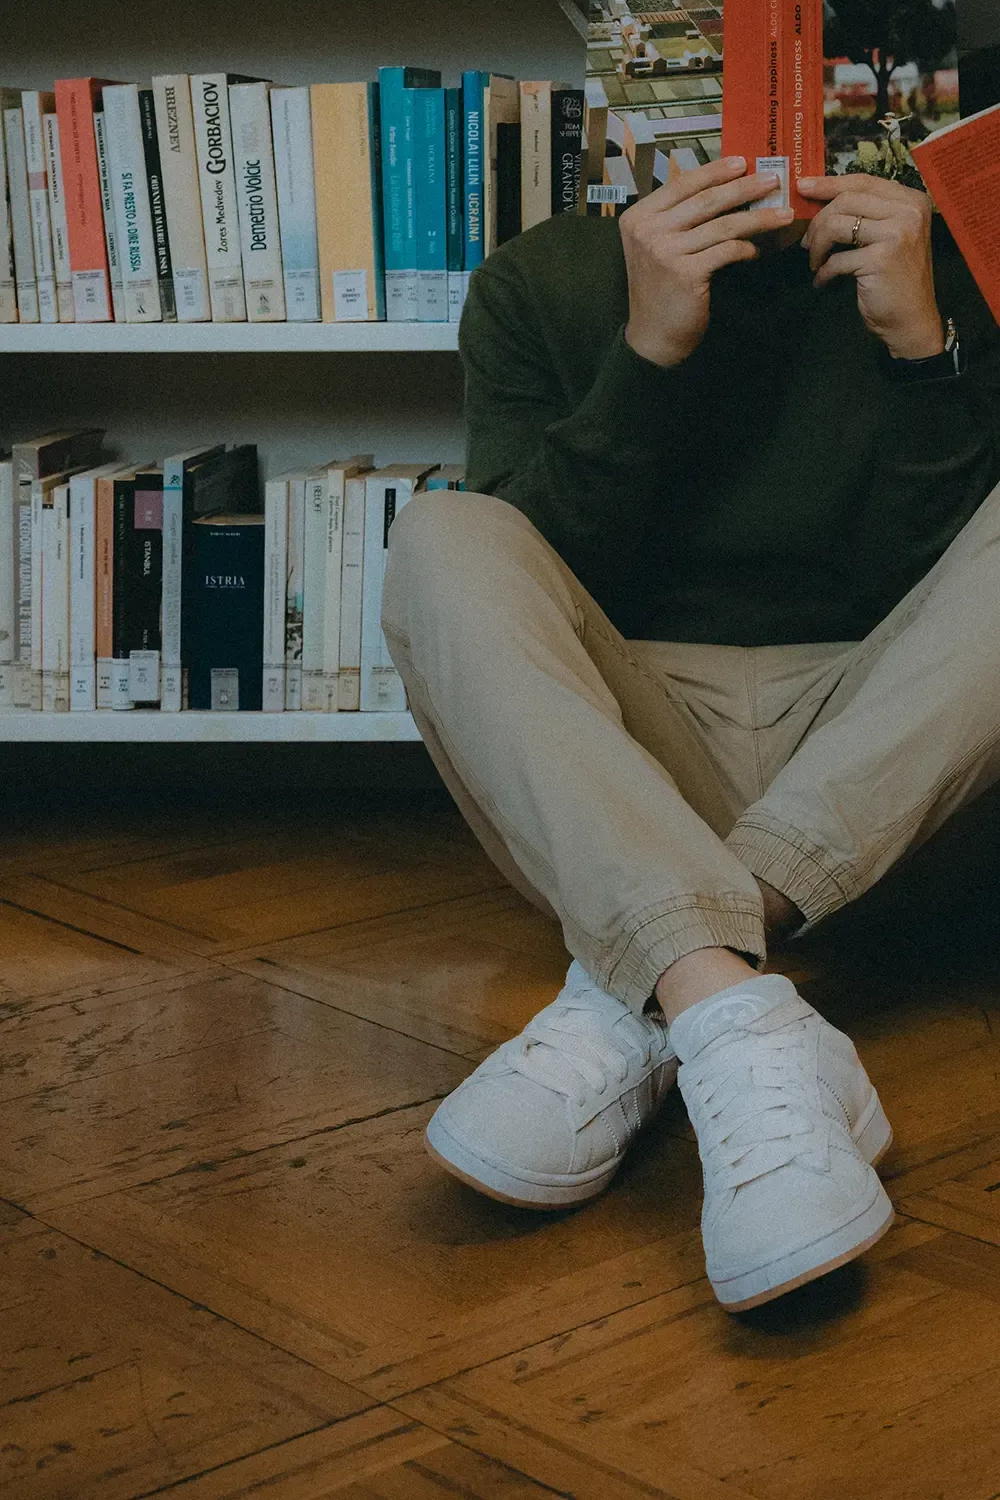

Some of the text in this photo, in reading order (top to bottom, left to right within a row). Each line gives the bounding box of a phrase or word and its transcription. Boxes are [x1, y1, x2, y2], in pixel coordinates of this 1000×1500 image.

[769, 12, 778, 38] ALDO
[794, 3, 802, 36] ALDO
[769, 40, 779, 97] happiness
[793, 39, 804, 108] happiness
[202, 81, 227, 175] GORBACIOV
[769, 98, 779, 157] rethinking
[793, 112, 803, 180] rethinking
[427, 143, 435, 185] UCRAINA
[467, 110, 479, 243] NICOLAI LILIN UCRAINA
[213, 179, 226, 225] Medvedev
[242, 159, 267, 251] Demetrio Volcic
[143, 539, 153, 577] ISTANBUL
[205, 574, 246, 586] ISTRIA
